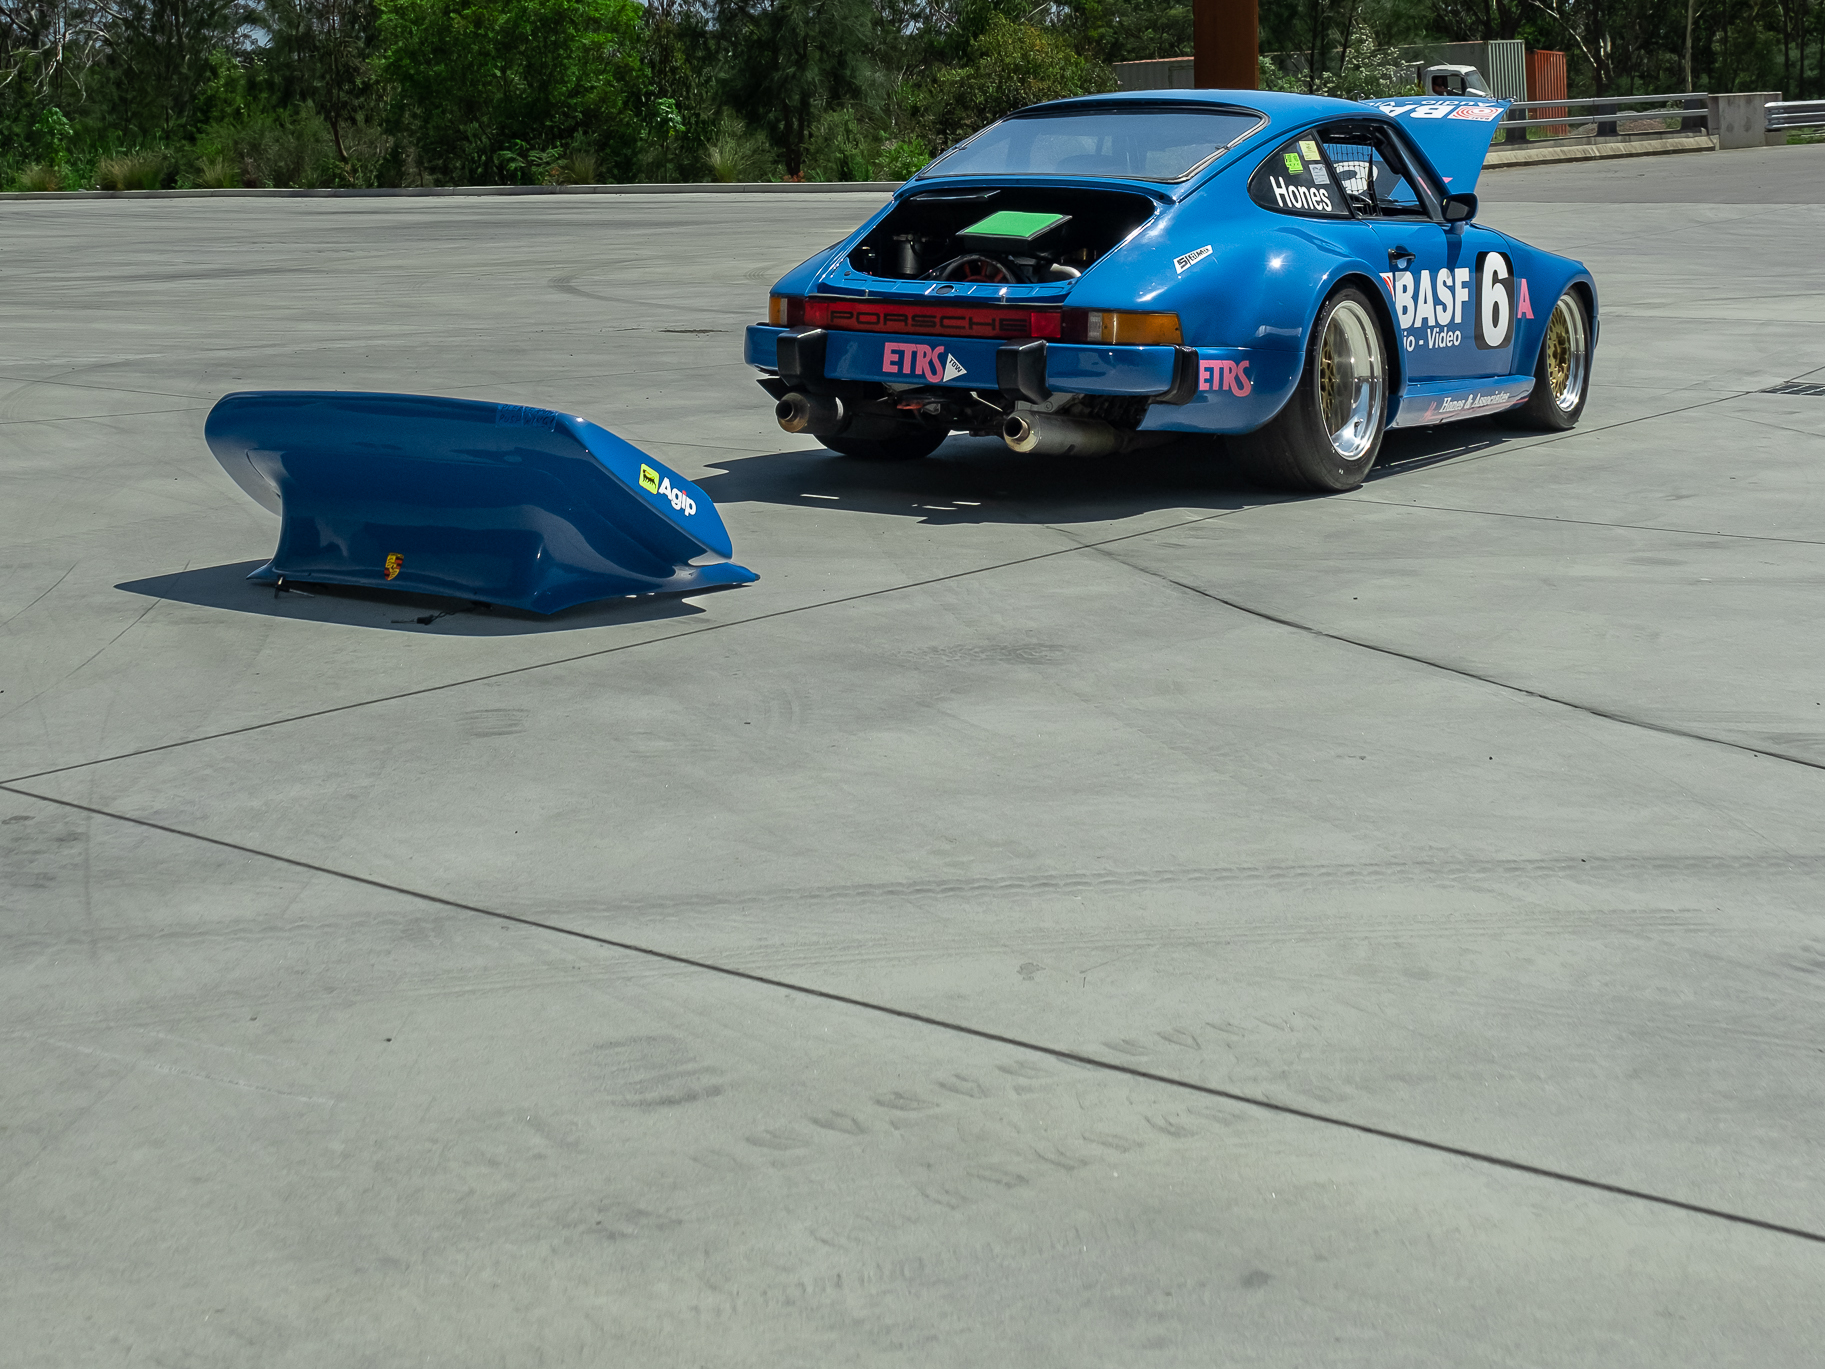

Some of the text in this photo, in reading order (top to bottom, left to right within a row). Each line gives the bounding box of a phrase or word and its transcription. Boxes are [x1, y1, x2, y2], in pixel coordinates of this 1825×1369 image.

[1379, 104, 1456, 118] BA
[1270, 176, 1332, 211] Hones
[1395, 268, 1469, 329] BASF
[1481, 251, 1510, 347] 6
[1517, 278, 1534, 319] A
[830, 310, 1028, 331] PORSCHE
[1427, 326, 1461, 349] Video
[882, 342, 945, 383] ETRS
[949, 358, 963, 373] TOW
[1199, 360, 1251, 397] ETRS
[1439, 390, 1510, 412] Hones & Associates
[659, 477, 697, 517] Agip
